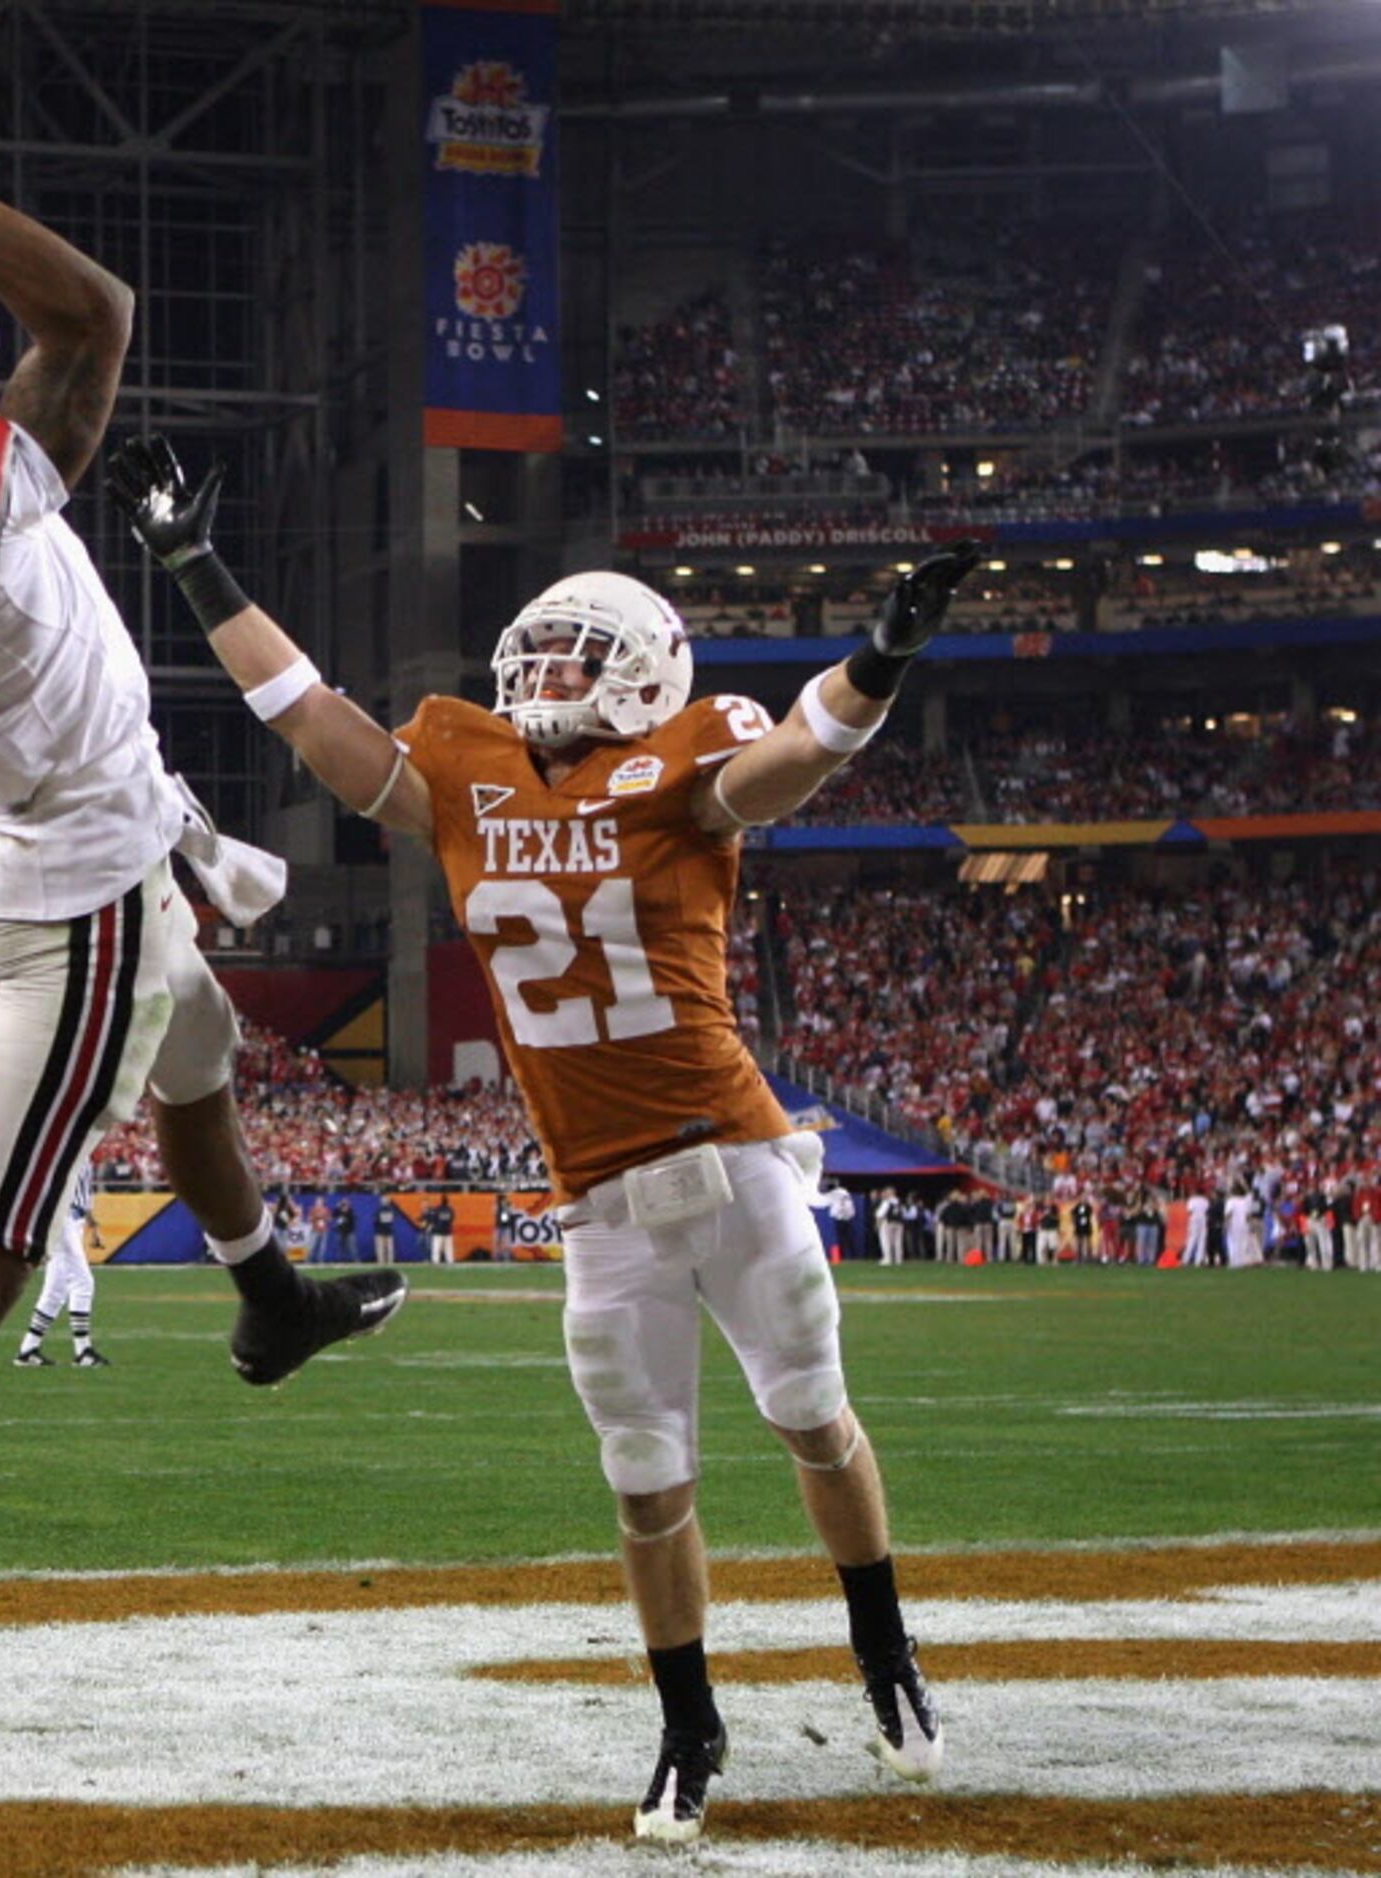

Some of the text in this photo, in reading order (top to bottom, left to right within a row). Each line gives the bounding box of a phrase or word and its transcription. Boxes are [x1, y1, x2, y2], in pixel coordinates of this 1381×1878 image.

[436, 317, 549, 343] FIESTA
[447, 341, 535, 363] BOWL
[676, 533, 730, 548] JOHN
[830, 527, 932, 545] DRISCOLL
[477, 818, 620, 874] TEXAS
[466, 877, 677, 1048] 21
